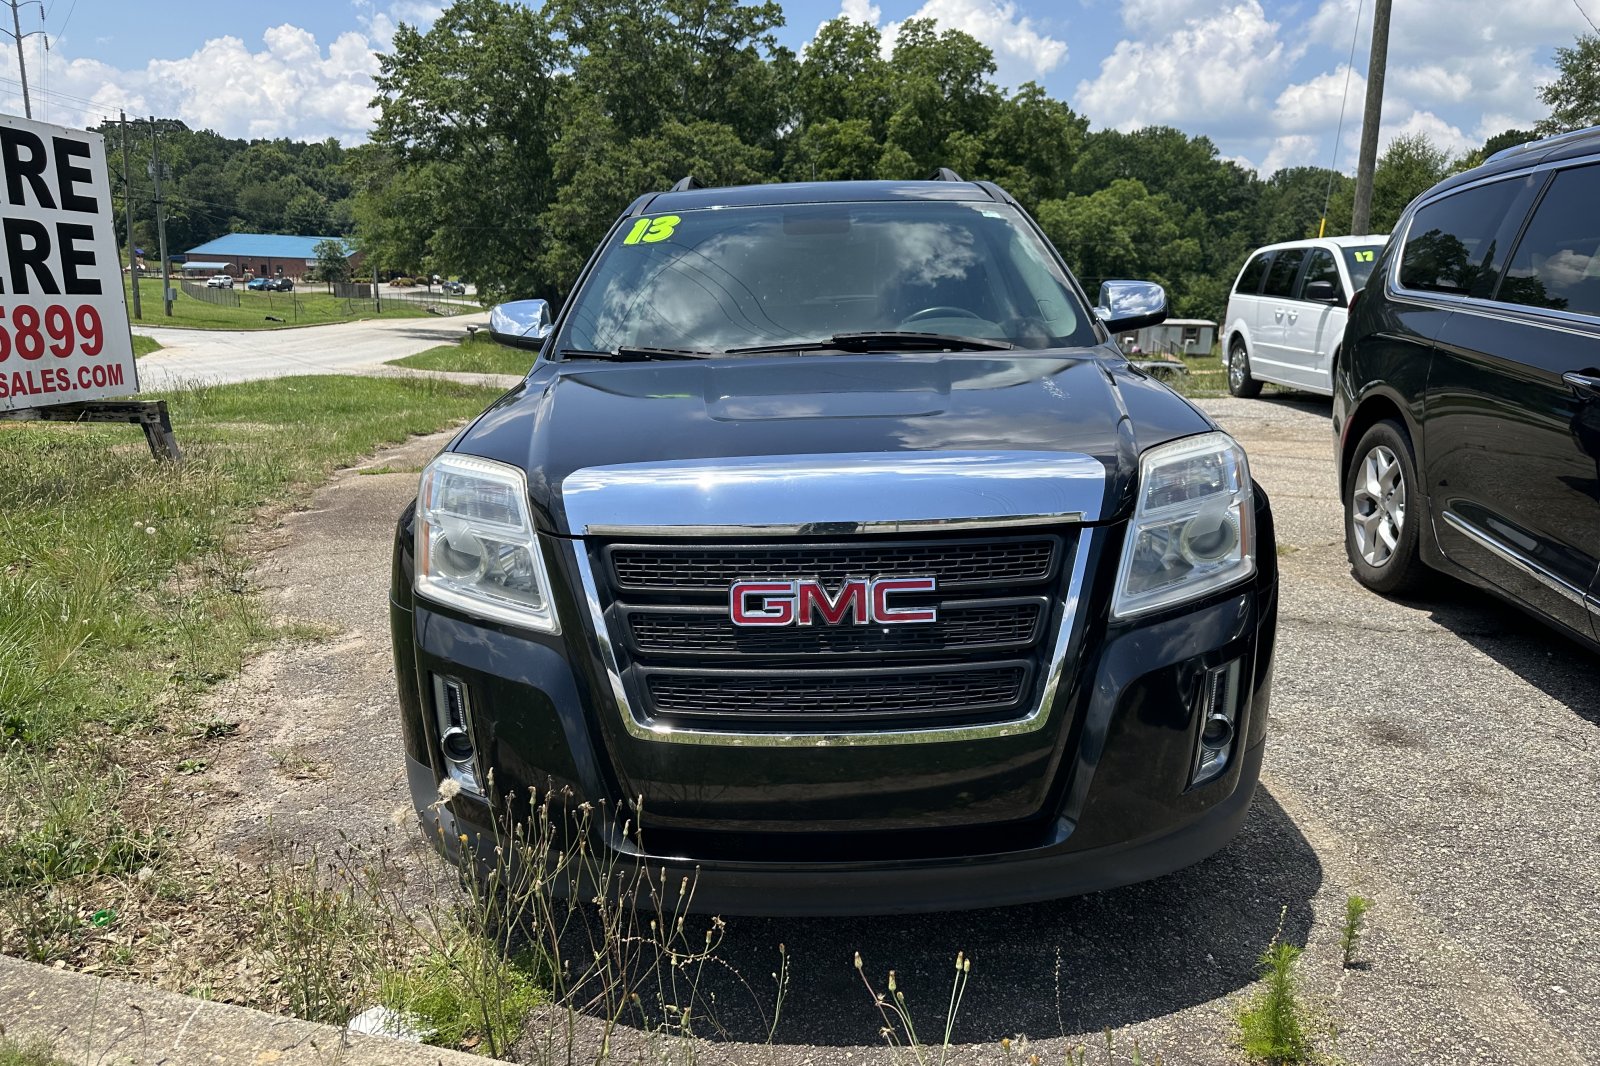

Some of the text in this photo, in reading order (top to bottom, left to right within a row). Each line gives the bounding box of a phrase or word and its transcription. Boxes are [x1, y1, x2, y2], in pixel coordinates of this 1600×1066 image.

[623, 215, 681, 245] 13
[0, 217, 103, 295] RE
[1354, 250, 1374, 262] 17
[729, 575, 937, 626] GMC
